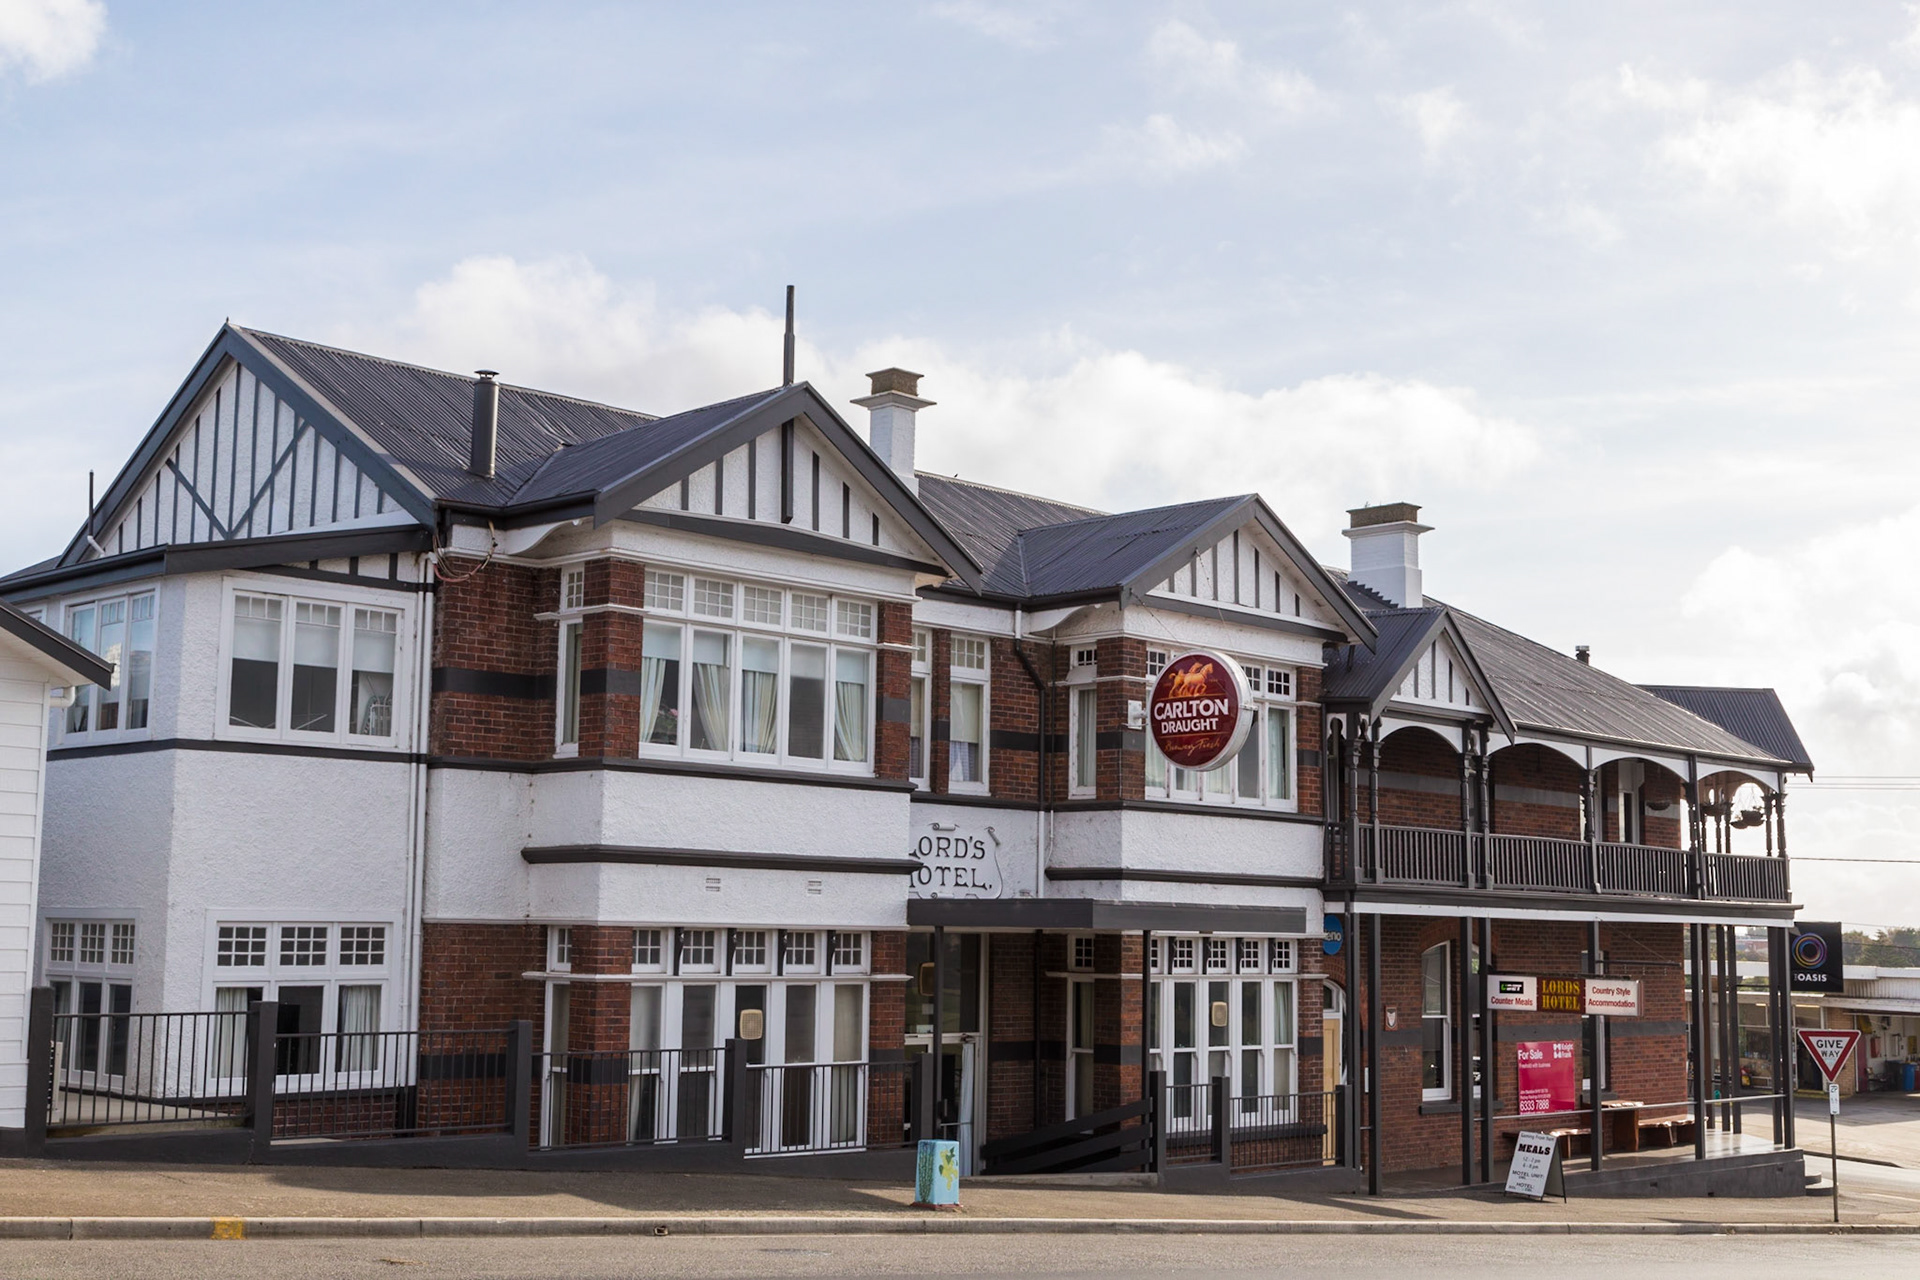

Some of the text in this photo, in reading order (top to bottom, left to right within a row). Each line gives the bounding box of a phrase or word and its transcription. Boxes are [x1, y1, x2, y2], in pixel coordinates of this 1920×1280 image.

[1154, 699, 1229, 721] CARLTON
[1161, 717, 1219, 734] DRAUGHT
[909, 836, 986, 860] ORD'S
[1797, 973, 1828, 982] OASIS
[1542, 980, 1580, 995] LORDS
[1592, 986, 1631, 997] Country Style
[1490, 996, 1533, 1006] Counter Meals
[1542, 995, 1580, 1010] HOTEL
[1588, 999, 1635, 1008] Accommodation
[1816, 1039, 1843, 1049] GIVE
[1518, 1049, 1543, 1060] For Sale
[1821, 1050, 1840, 1058] WAY
[1518, 1143, 1551, 1155] MEALS
